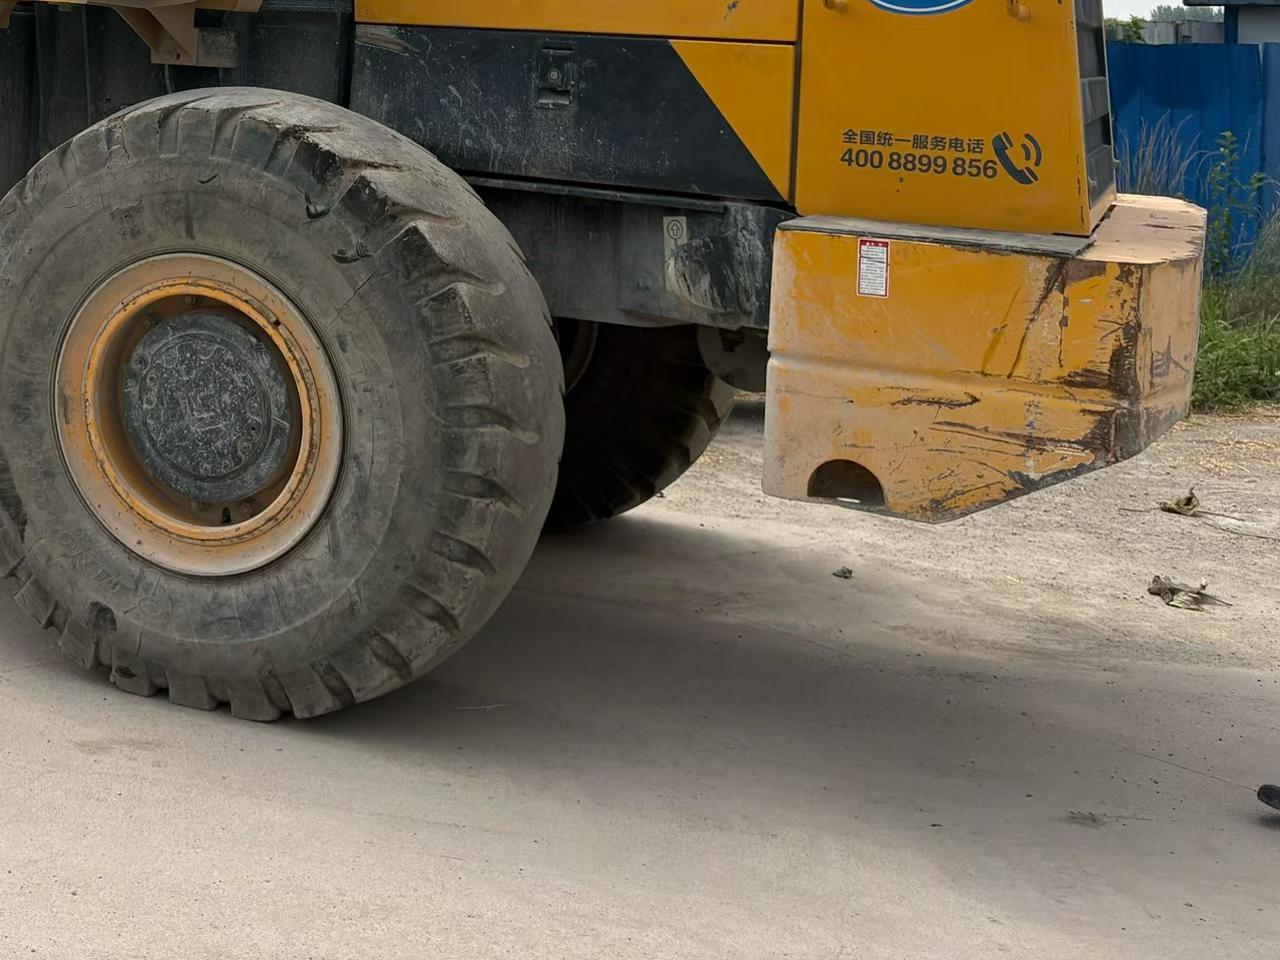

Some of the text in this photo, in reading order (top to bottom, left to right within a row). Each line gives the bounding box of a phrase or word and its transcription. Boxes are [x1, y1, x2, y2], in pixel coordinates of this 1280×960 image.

[842, 128, 985, 155] 全国统一服务电话
[841, 147, 998, 179] 400 8899 856
